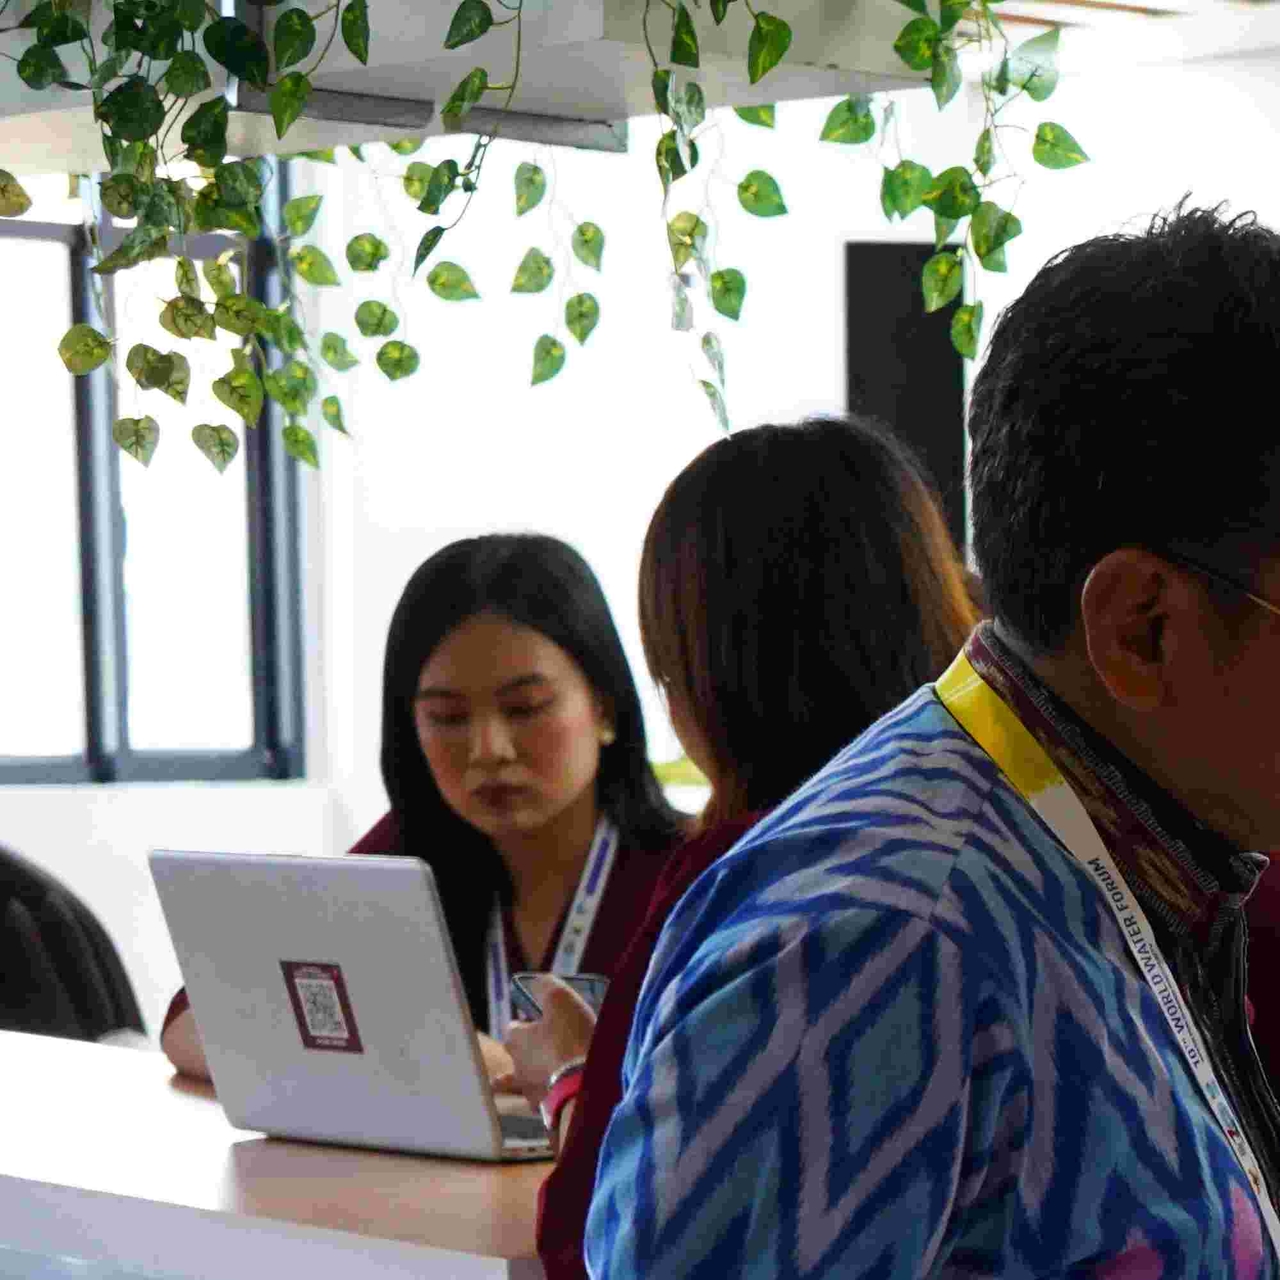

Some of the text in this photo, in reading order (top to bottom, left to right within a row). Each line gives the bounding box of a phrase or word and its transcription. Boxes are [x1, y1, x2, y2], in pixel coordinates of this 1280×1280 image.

[1088, 857, 1131, 911] FORUM
[1123, 915, 1157, 971] WATER
[1152, 973, 1185, 1034] WORLD
